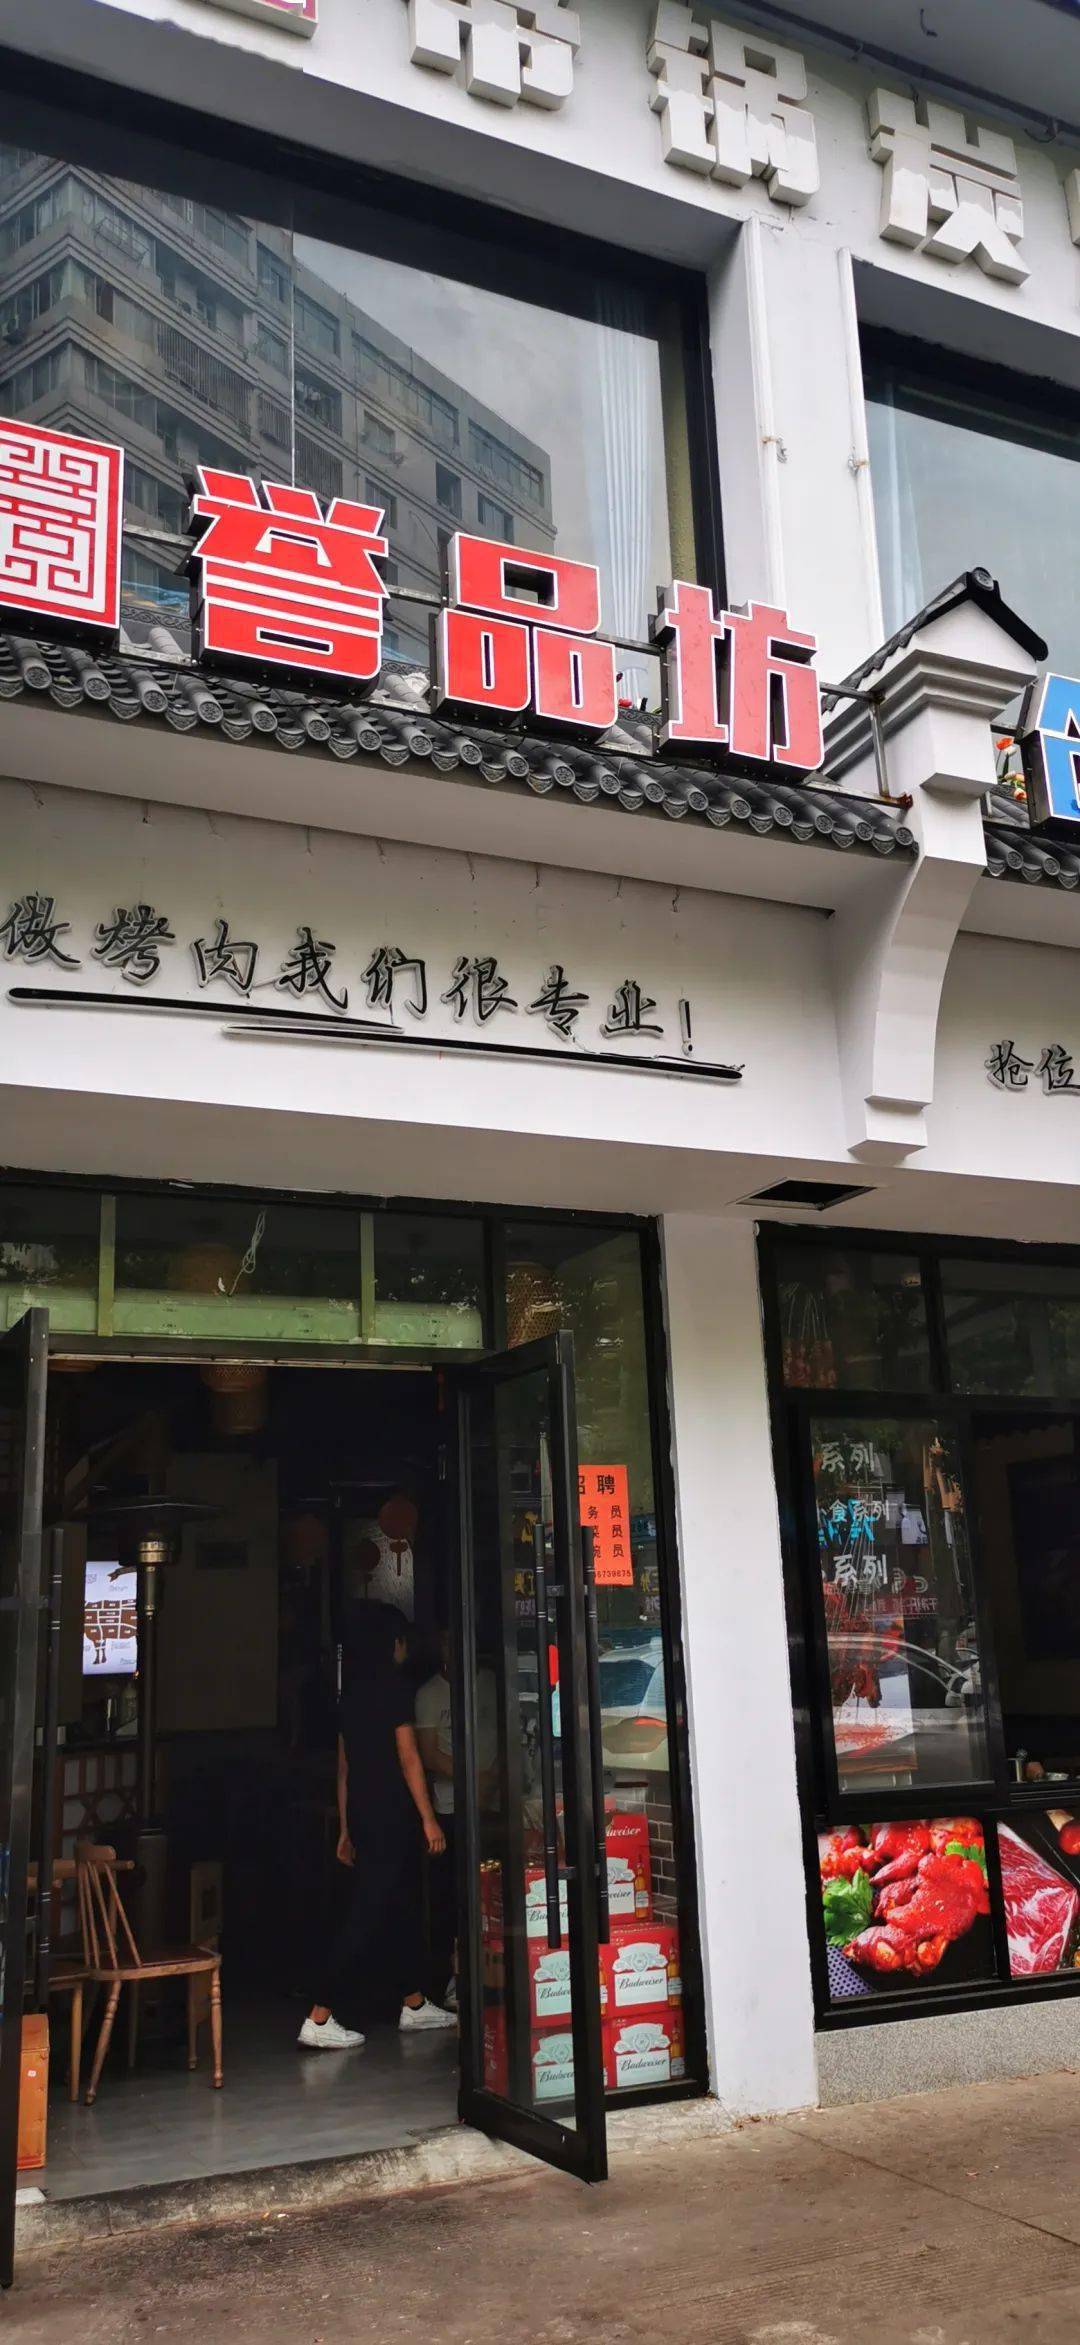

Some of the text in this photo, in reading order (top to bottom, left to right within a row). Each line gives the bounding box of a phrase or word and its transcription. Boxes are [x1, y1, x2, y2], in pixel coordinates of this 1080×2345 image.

[190, 465, 827, 772] 誉品坊
[0, 893, 694, 1057] 做烤肉我们很专业！
[984, 1039, 1080, 1096] 抢位
[821, 1442, 875, 1473] 系列
[821, 1499, 890, 1522] 食系列
[618, 1976, 664, 1990] Budweiser
[620, 2057, 667, 2072] Budweiser
